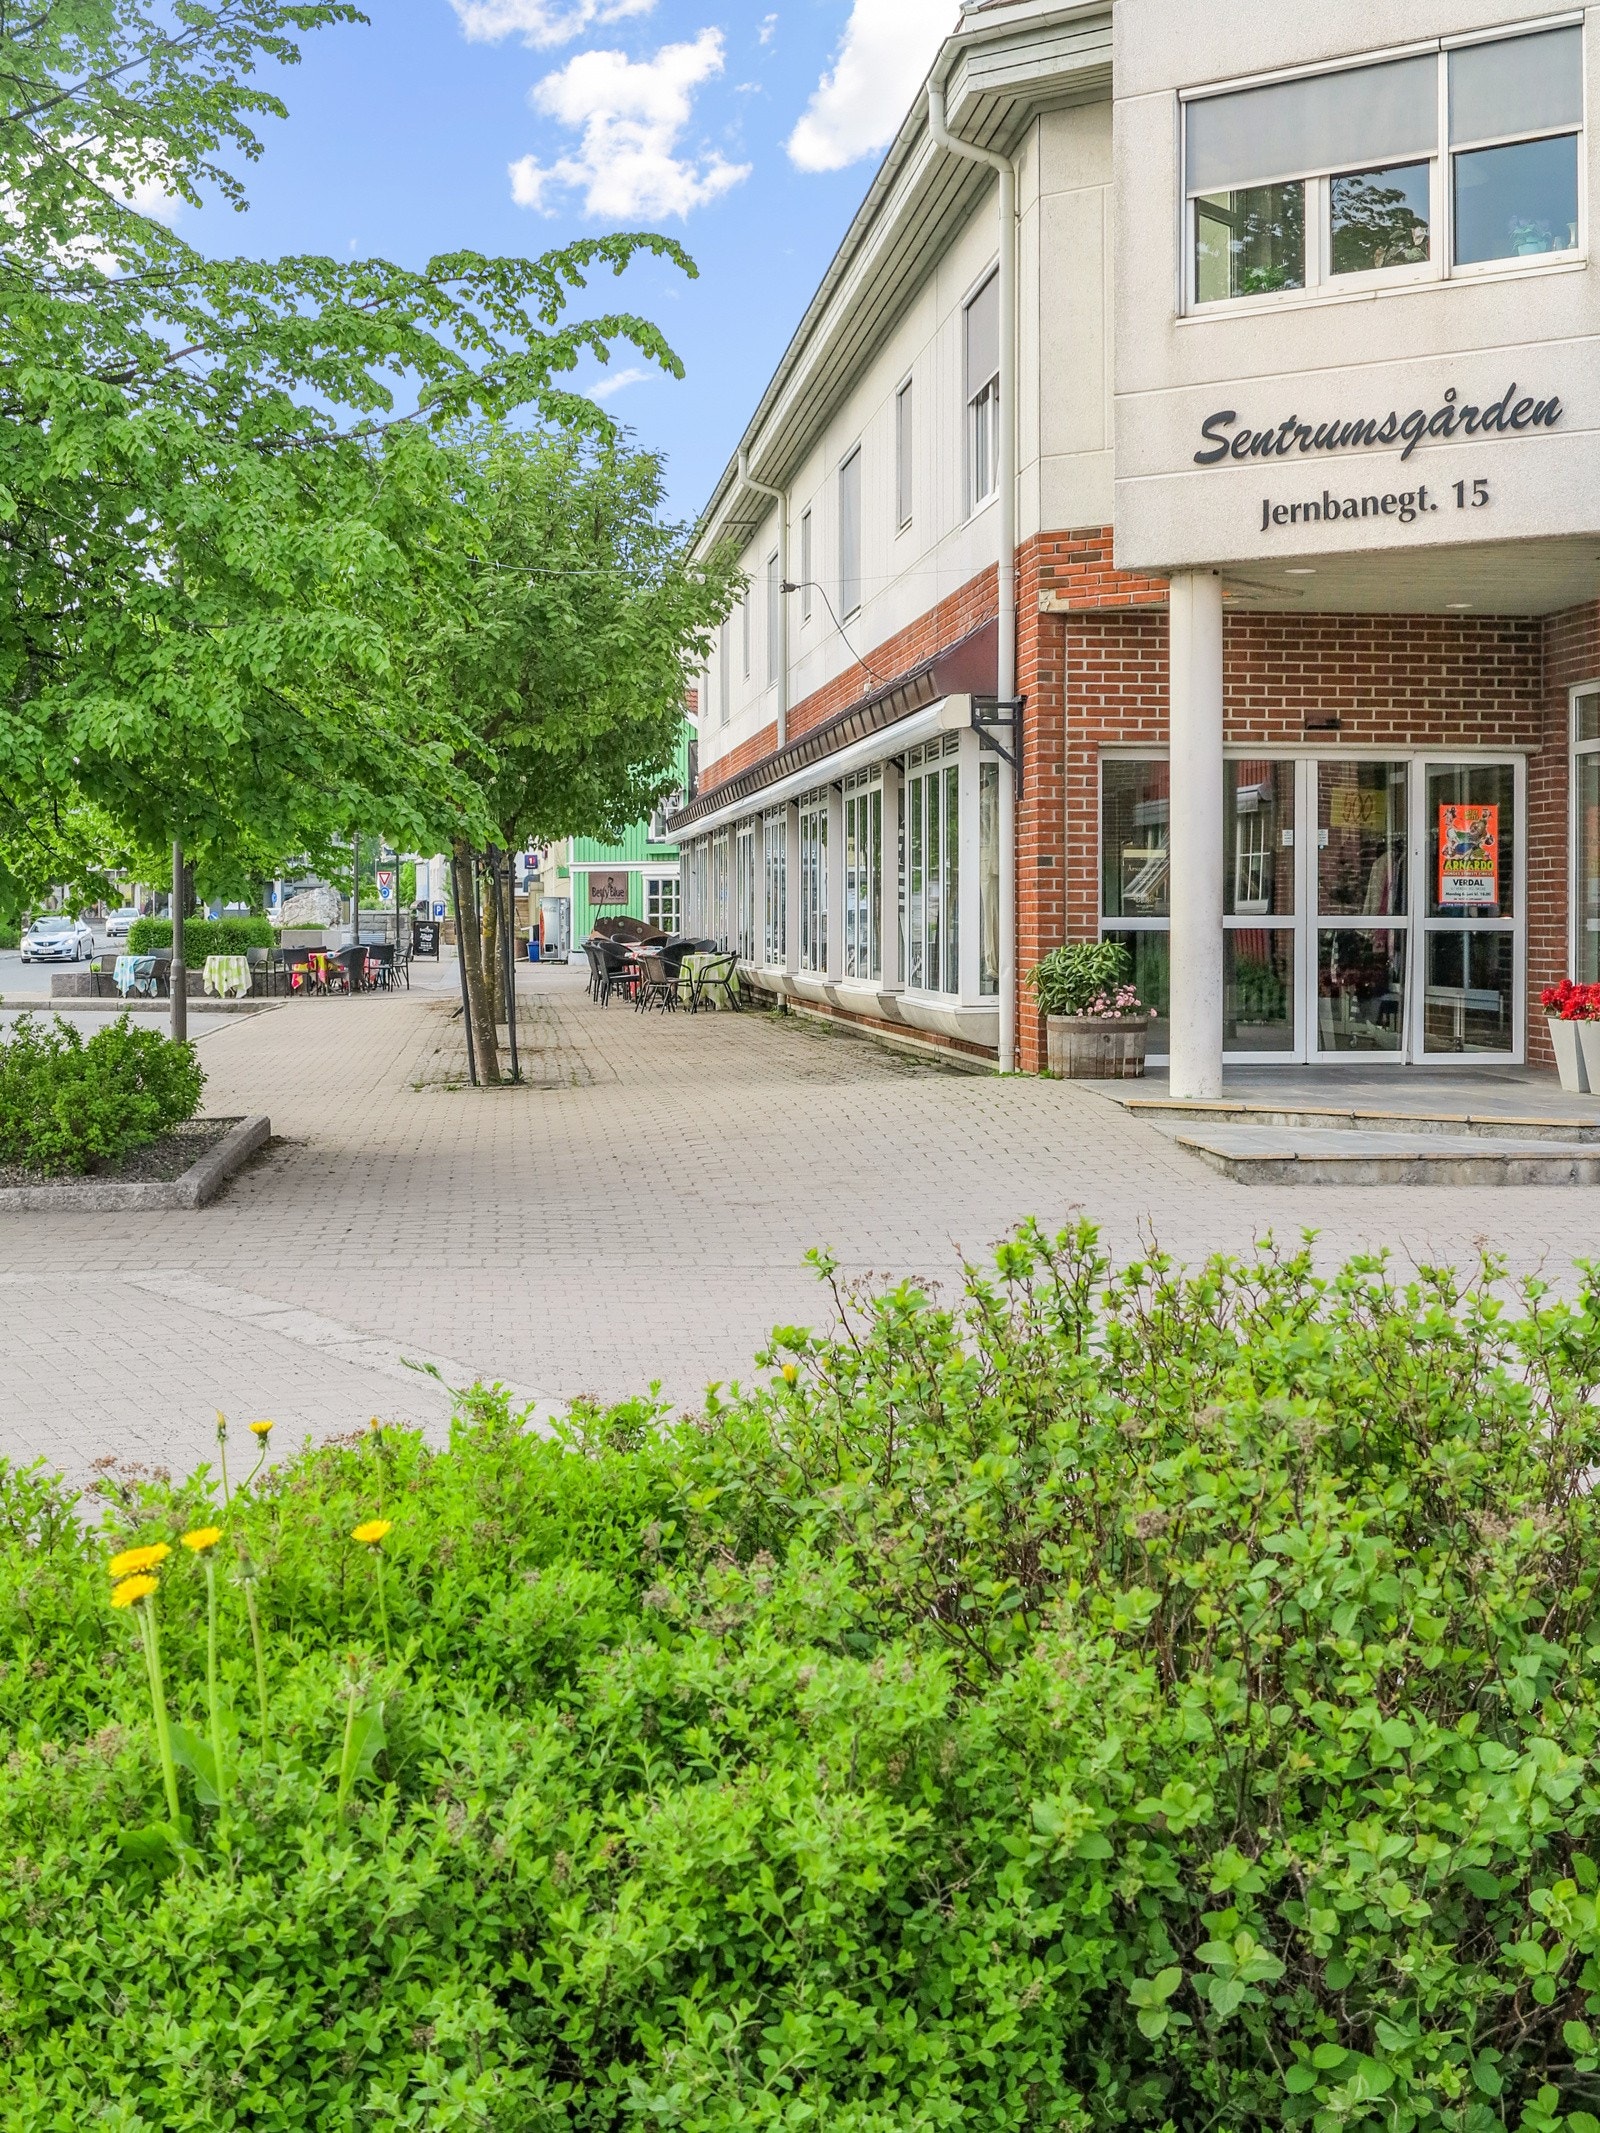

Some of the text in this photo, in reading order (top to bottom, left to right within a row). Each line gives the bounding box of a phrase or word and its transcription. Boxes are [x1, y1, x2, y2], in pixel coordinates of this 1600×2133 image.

[1193, 382, 1564, 465] Sentrumsgården
[1260, 478, 1490, 532] Jernbanegt. 15
[1444, 860, 1494, 871] ARNARDO
